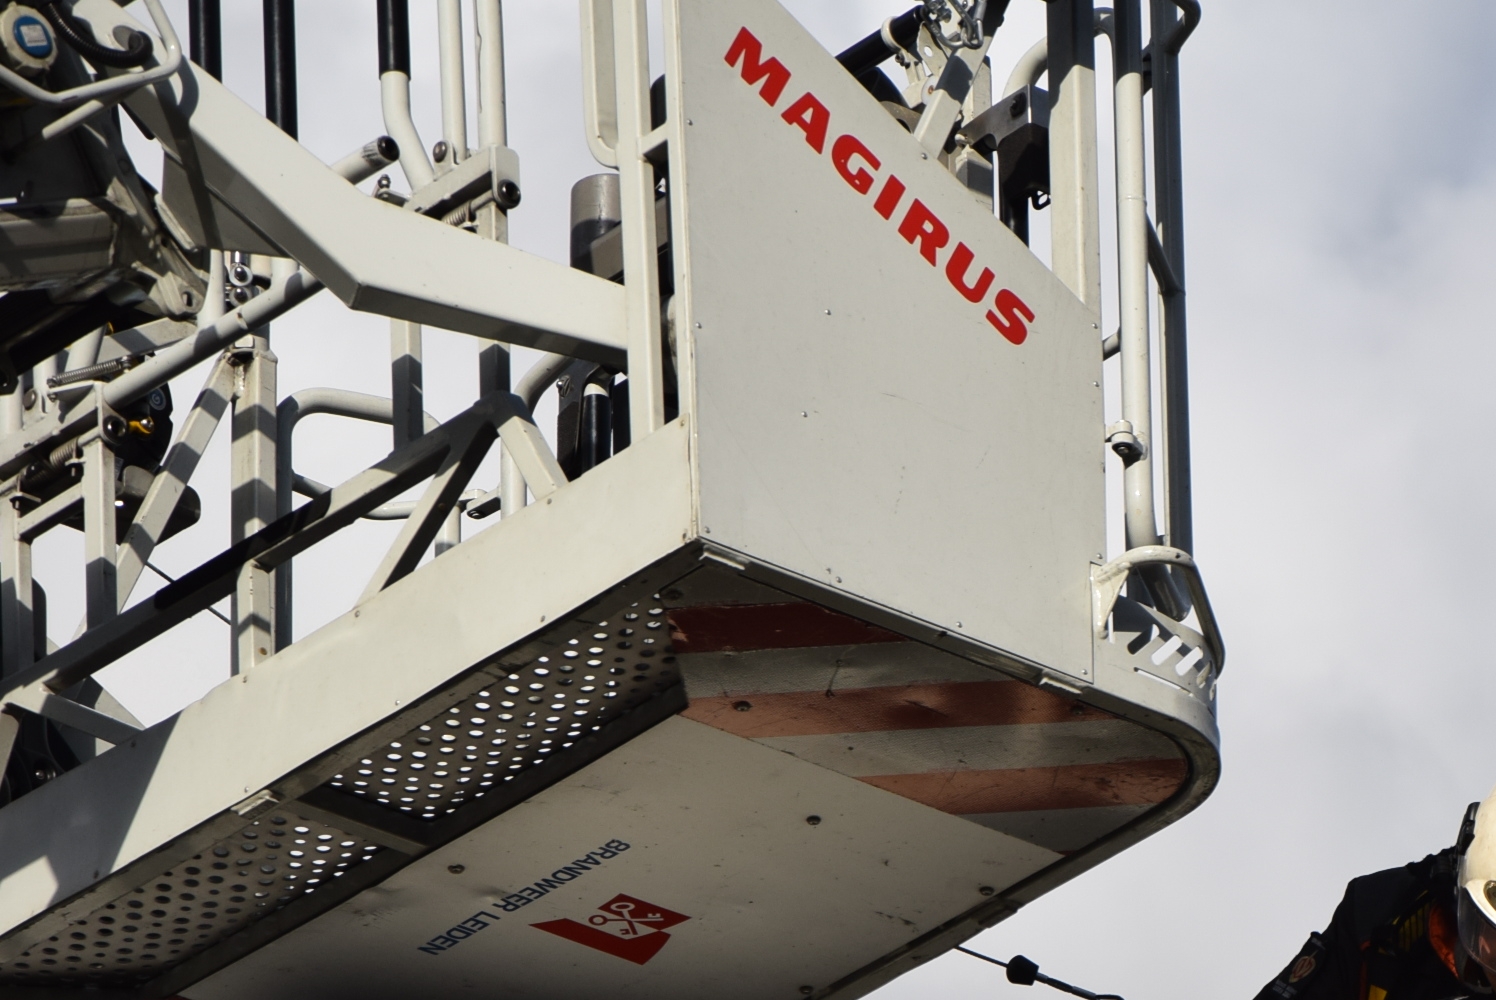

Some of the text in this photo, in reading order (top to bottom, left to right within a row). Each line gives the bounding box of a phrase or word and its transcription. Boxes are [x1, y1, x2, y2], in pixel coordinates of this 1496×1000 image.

[724, 26, 1035, 345] MAGIRUS
[417, 839, 631, 956] BRANDWEER LEIDEN
